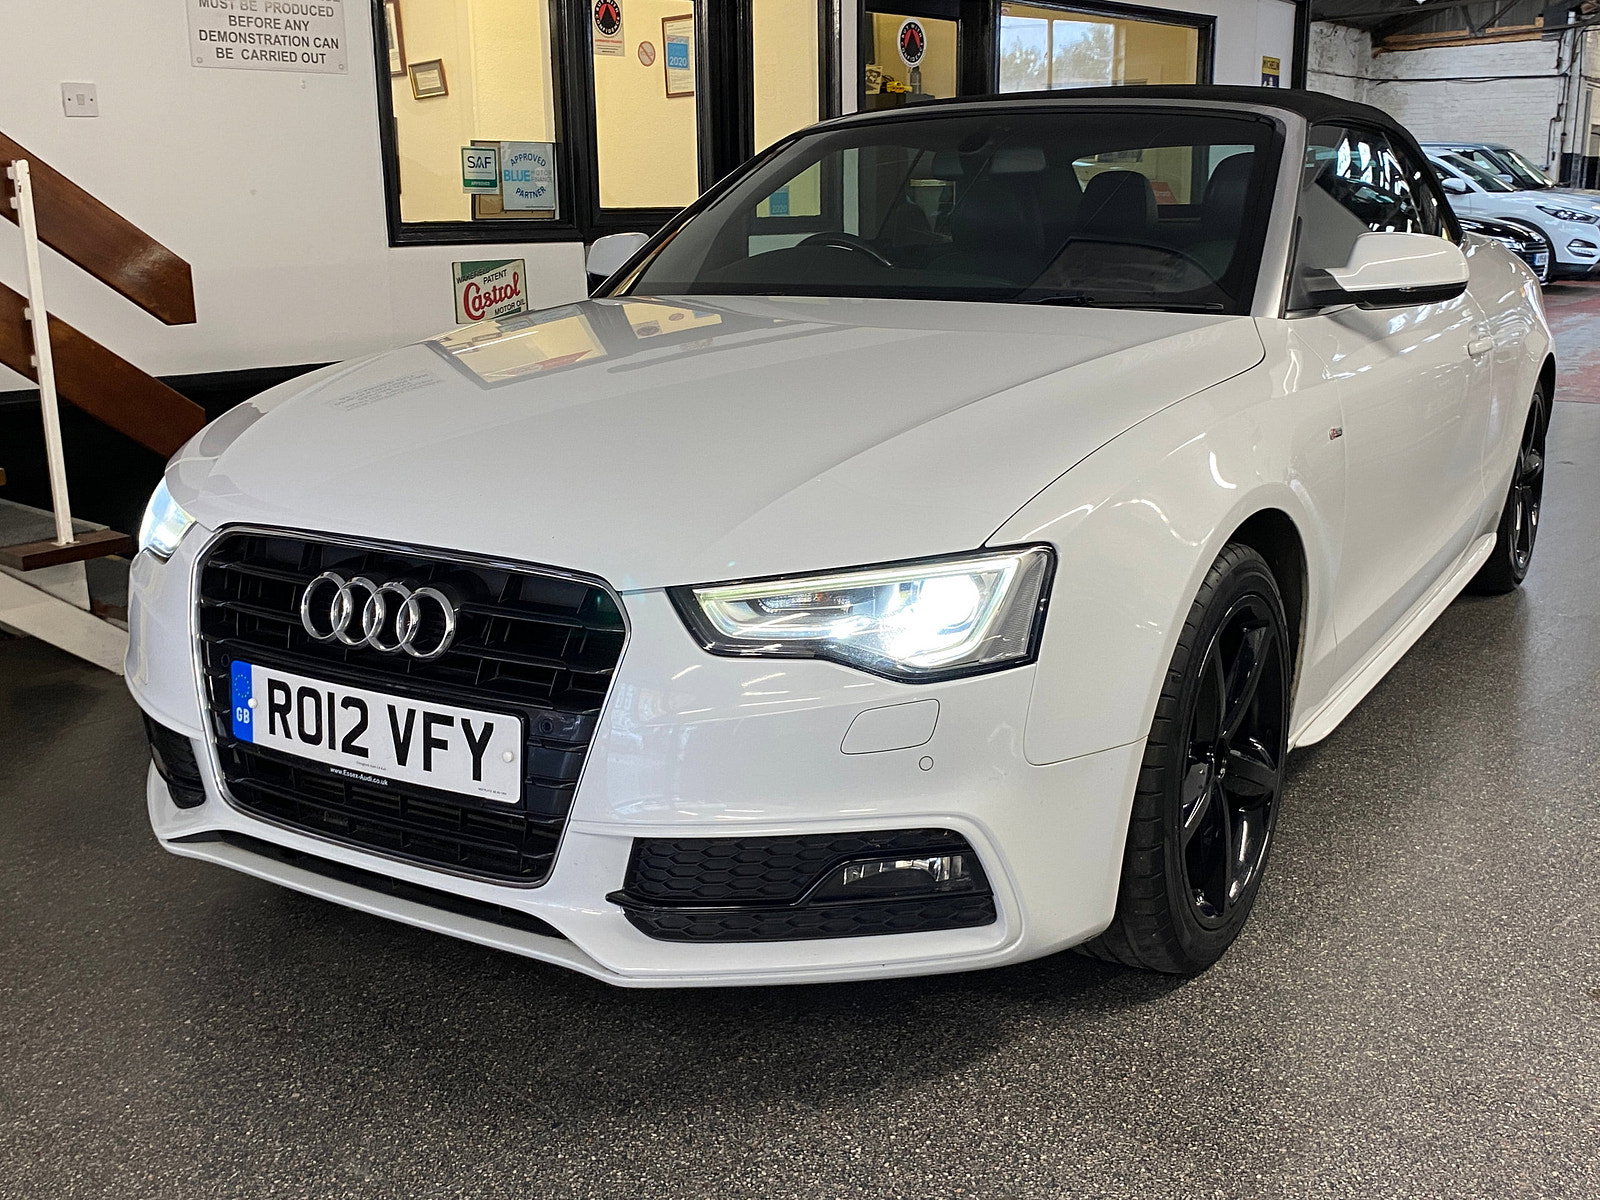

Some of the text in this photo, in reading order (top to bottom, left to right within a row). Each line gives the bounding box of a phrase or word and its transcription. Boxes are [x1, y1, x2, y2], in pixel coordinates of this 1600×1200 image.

[199, 0, 334, 18] MUST BE PRODUCED
[228, 15, 310, 32] BEFORE ANY
[595, 14, 620, 34] CONFIDENCE
[198, 29, 340, 50] DEMONSTRATION CAN
[216, 47, 327, 64] BE CARRIED OUT
[669, 56, 688, 67] 2020
[467, 155, 492, 169] SAF
[510, 153, 547, 167] APPROVED
[503, 169, 531, 182] BLUE
[515, 186, 546, 200] PARTNER
[483, 269, 507, 284] PATENT
[463, 271, 521, 321] Castrol
[494, 299, 526, 316] MOTOR OIL
[236, 706, 250, 724] GB
[267, 677, 495, 782] RO12 VFY
[329, 767, 389, 787] www.Essex-Audi.co.uk
